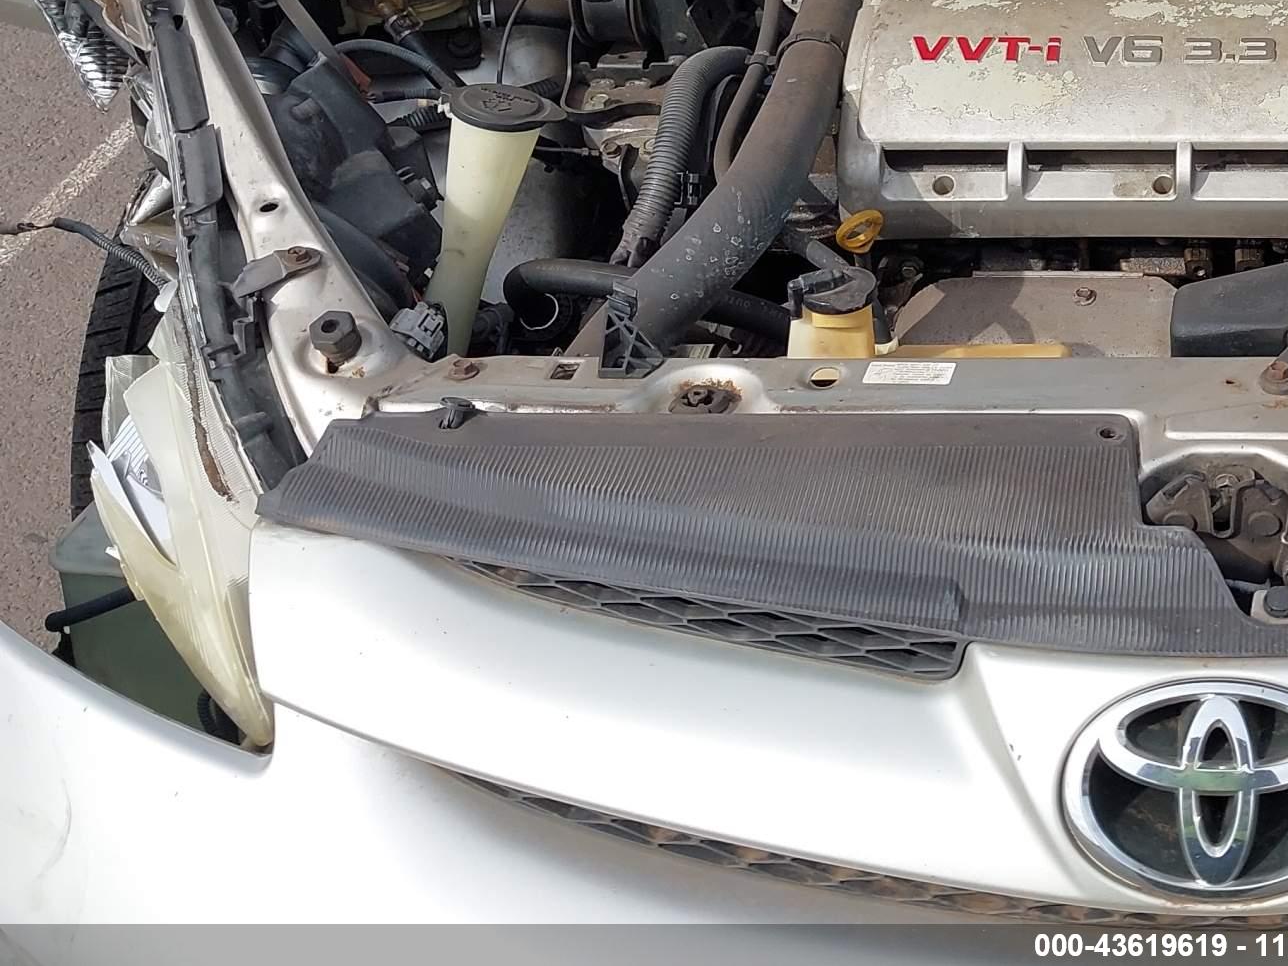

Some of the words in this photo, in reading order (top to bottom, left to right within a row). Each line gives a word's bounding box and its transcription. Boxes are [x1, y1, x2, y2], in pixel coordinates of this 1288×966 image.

[912, 35, 1063, 65] VVT-i
[1082, 35, 1164, 67] V6
[1184, 36, 1279, 65] 3.3
